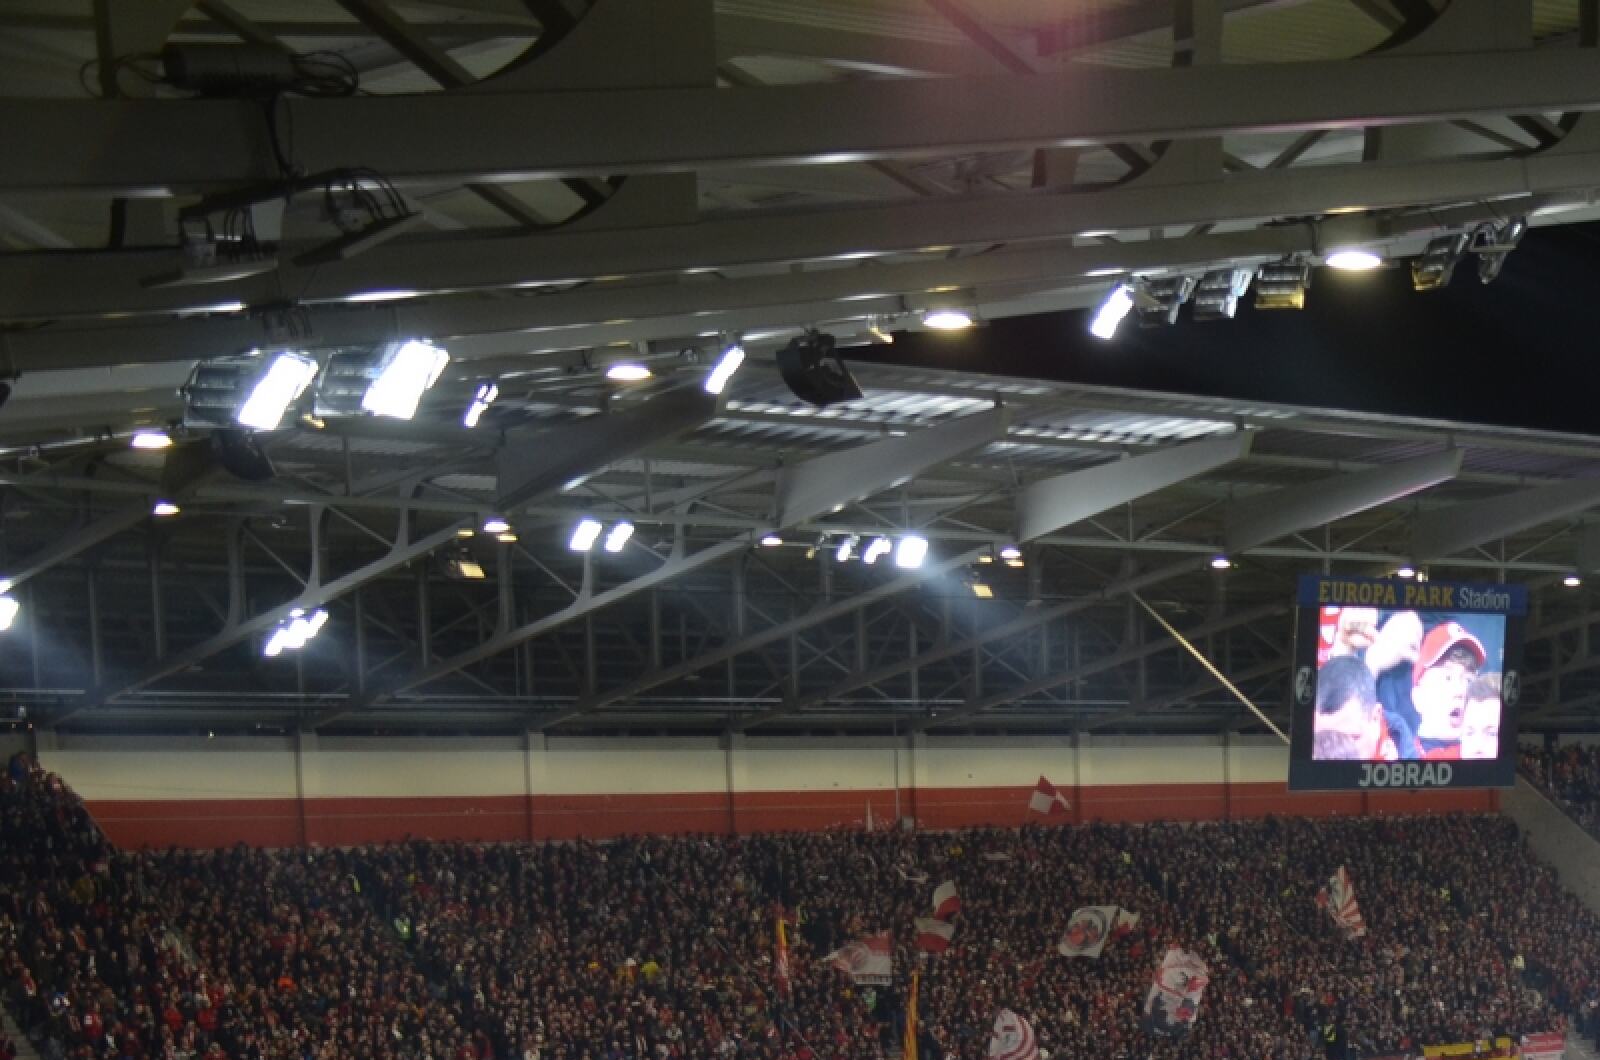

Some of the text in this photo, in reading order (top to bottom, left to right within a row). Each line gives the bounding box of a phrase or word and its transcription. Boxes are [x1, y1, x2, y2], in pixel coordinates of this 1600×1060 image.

[1319, 582, 1510, 609] EUROPA PARK Stadion
[1358, 762, 1453, 786] JOBRAD
